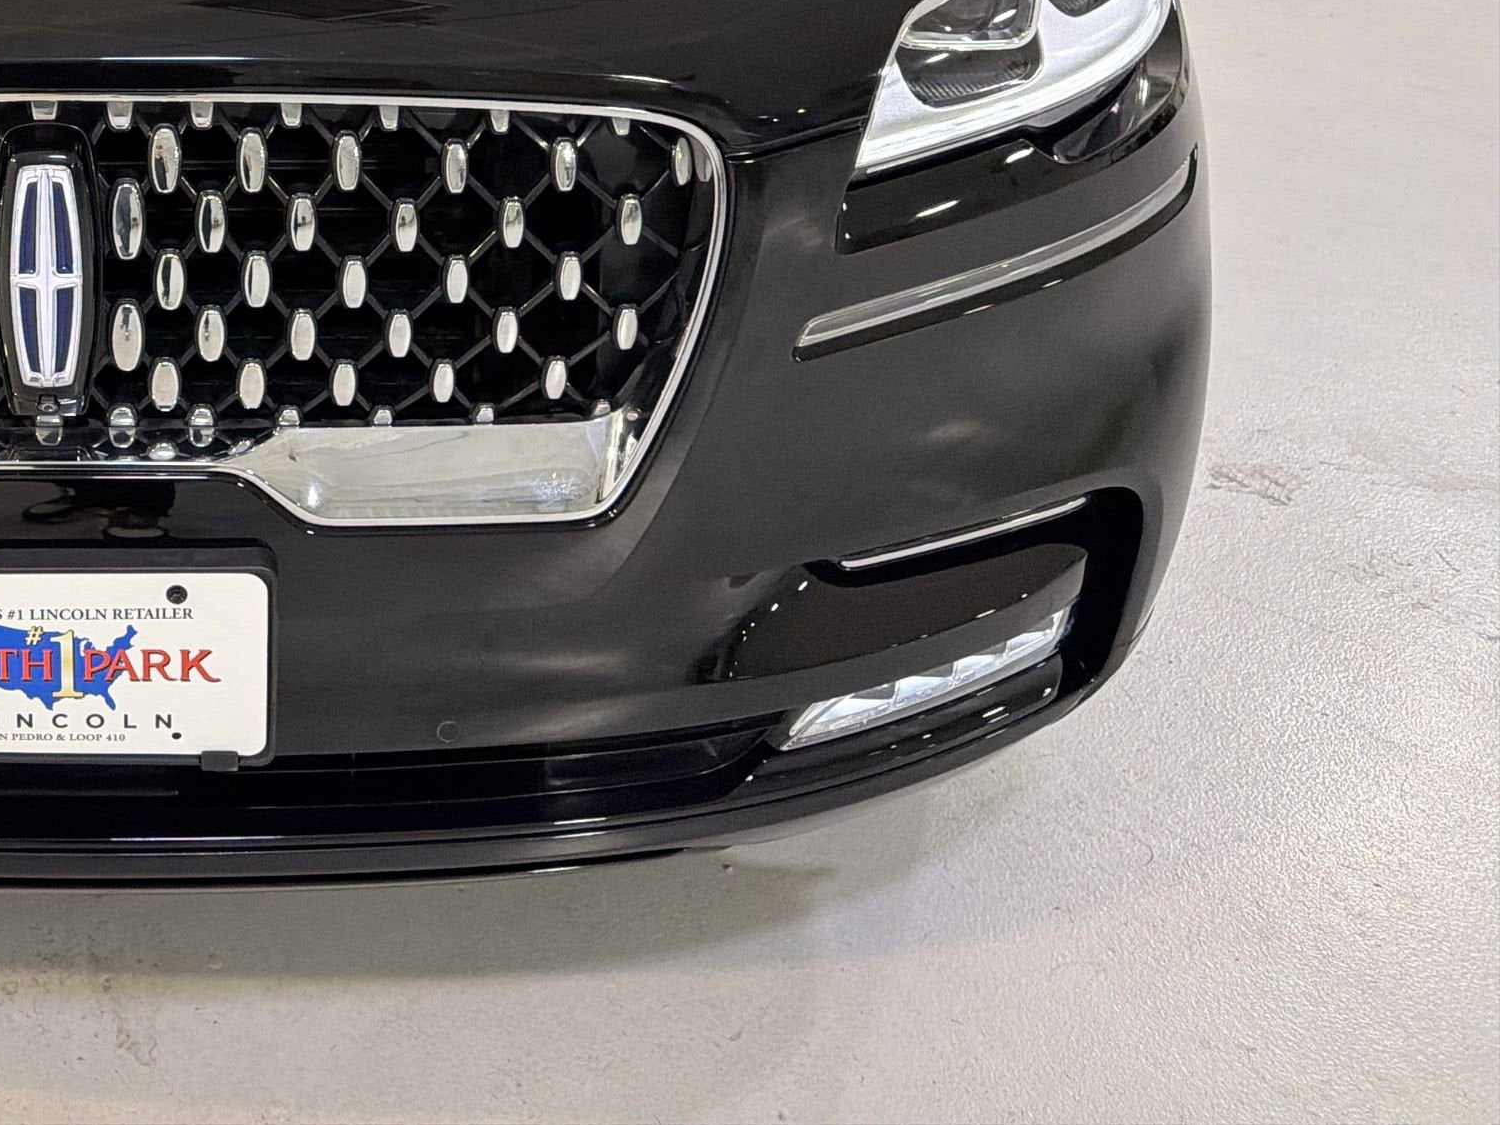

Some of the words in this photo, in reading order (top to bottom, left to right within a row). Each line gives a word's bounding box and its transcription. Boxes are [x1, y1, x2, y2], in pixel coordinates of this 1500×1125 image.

[7, 608, 24, 620] #1
[30, 608, 107, 620] LINCOLN
[112, 608, 194, 620] RETAILER
[83, 649, 222, 683] PARK
[11, 732, 53, 741] PEDRO
[56, 732, 66, 741] &
[69, 732, 103, 742] LOOP
[105, 732, 126, 742] 410
